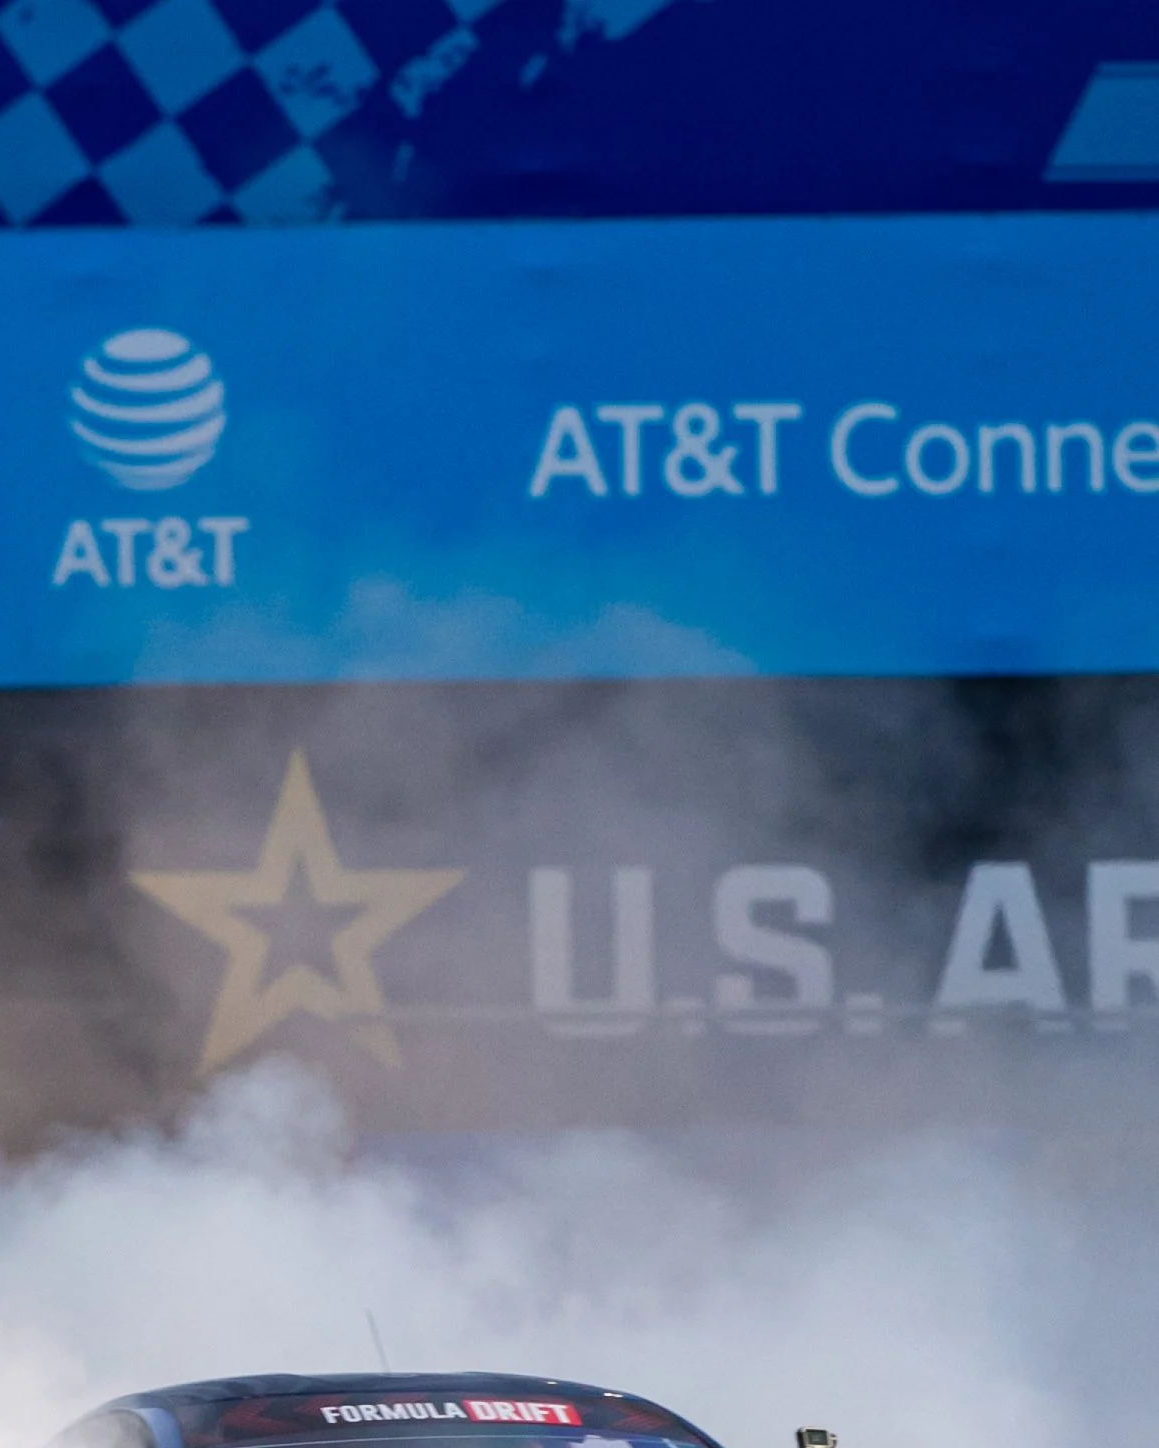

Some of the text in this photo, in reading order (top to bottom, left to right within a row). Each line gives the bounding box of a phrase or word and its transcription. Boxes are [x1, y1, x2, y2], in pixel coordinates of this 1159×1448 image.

[528, 402, 1159, 497] AT&T Conne
[51, 516, 250, 589] AT&T
[527, 864, 883, 1036] U.S.
[320, 1400, 572, 1424] FORMULA DRIFT
